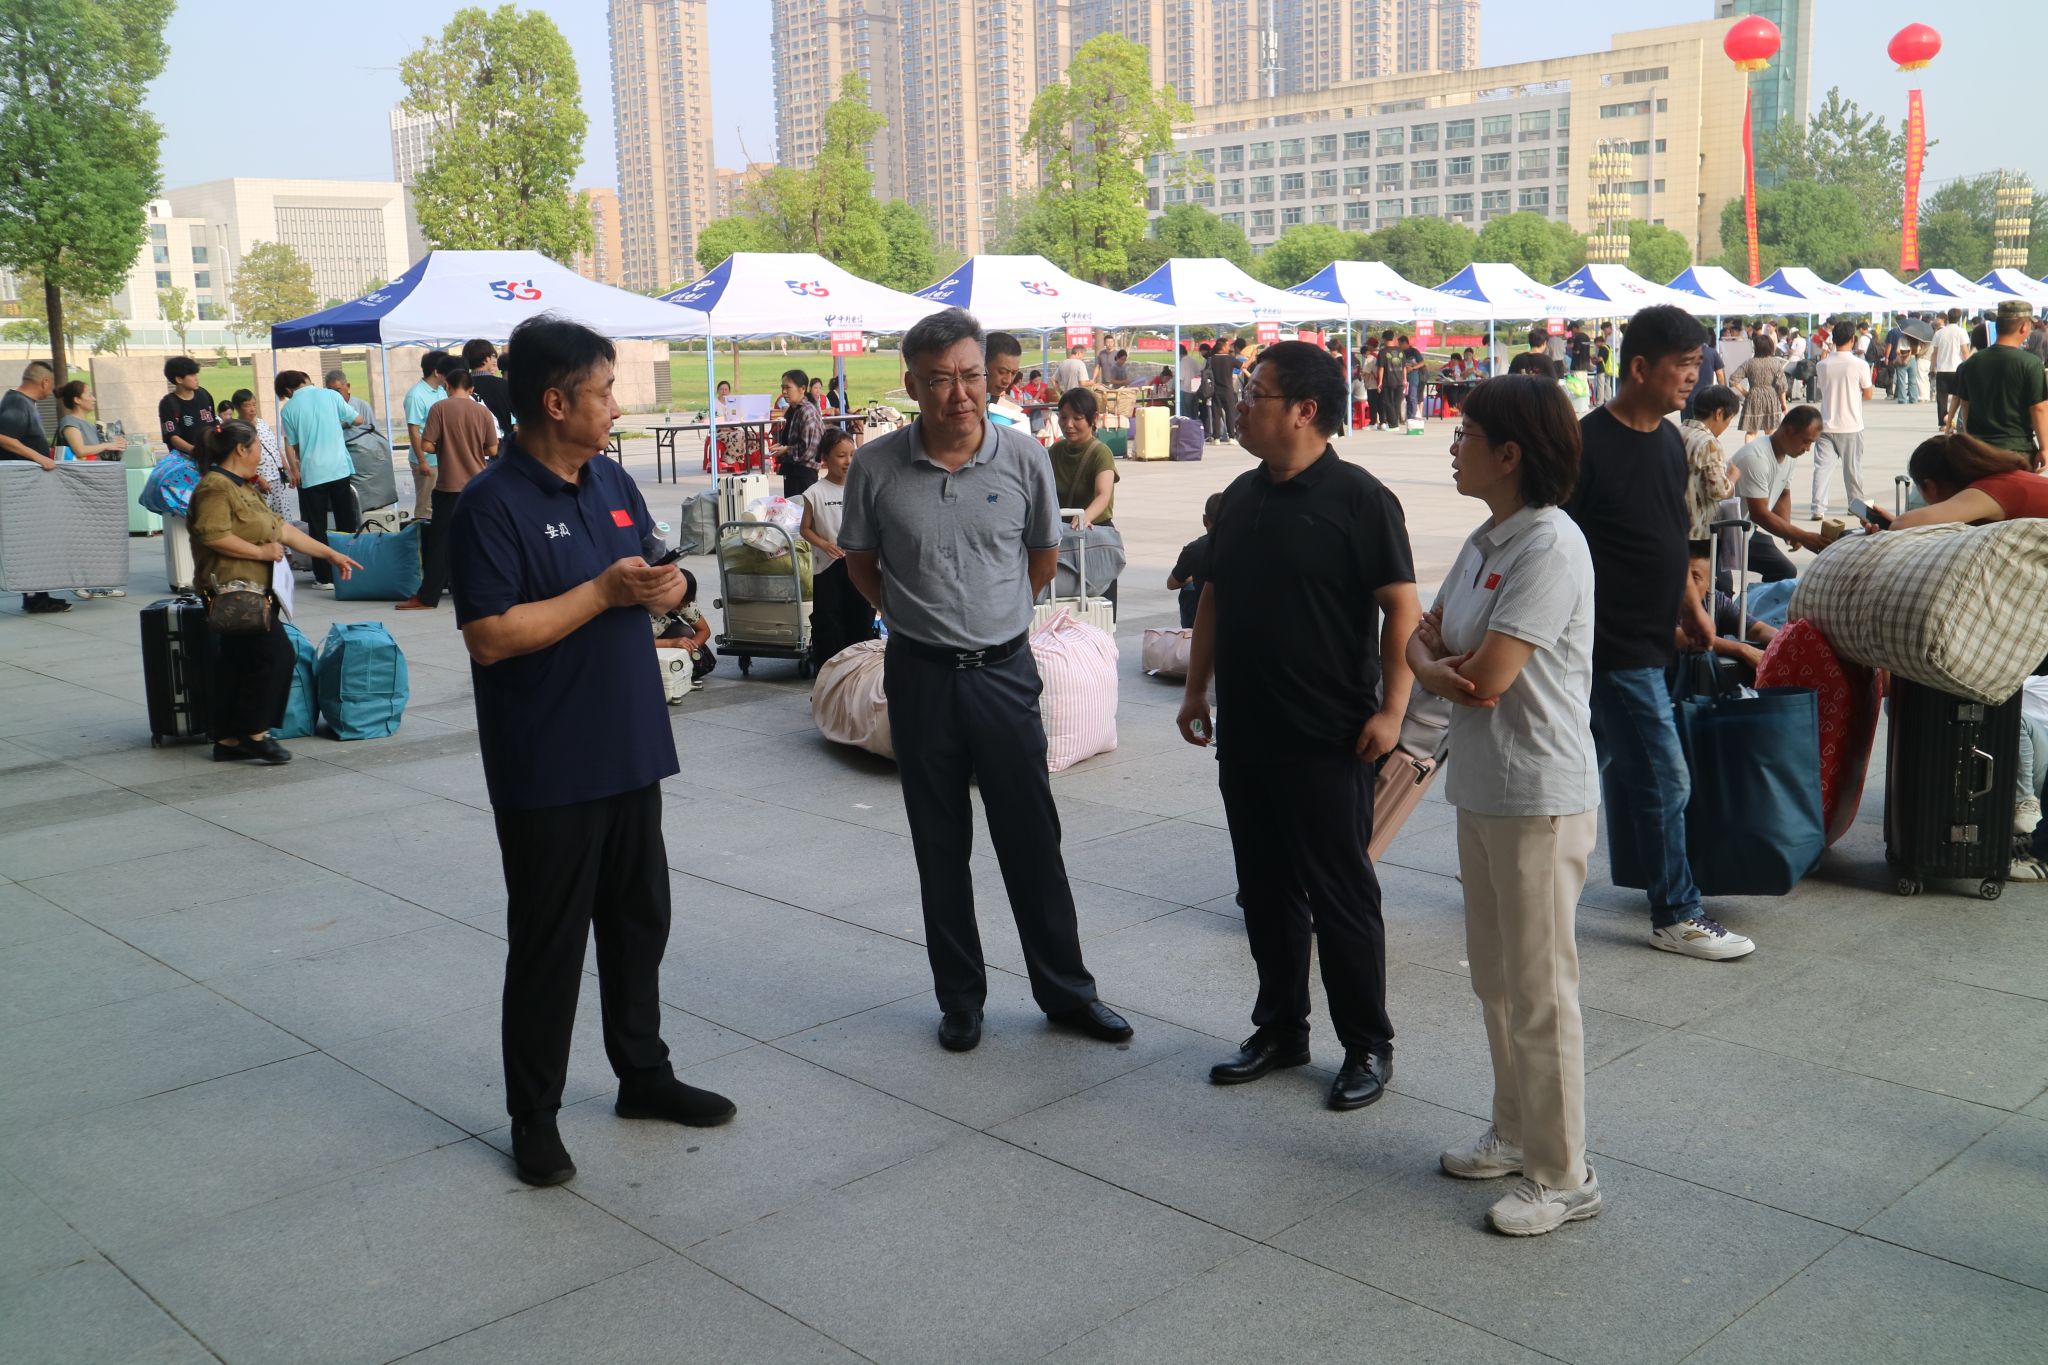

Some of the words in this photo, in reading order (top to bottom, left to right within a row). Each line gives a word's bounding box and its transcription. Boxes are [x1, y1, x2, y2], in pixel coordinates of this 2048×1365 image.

[489, 279, 542, 301] 5G
[784, 280, 830, 297] 5G
[1019, 281, 1059, 297] 5G
